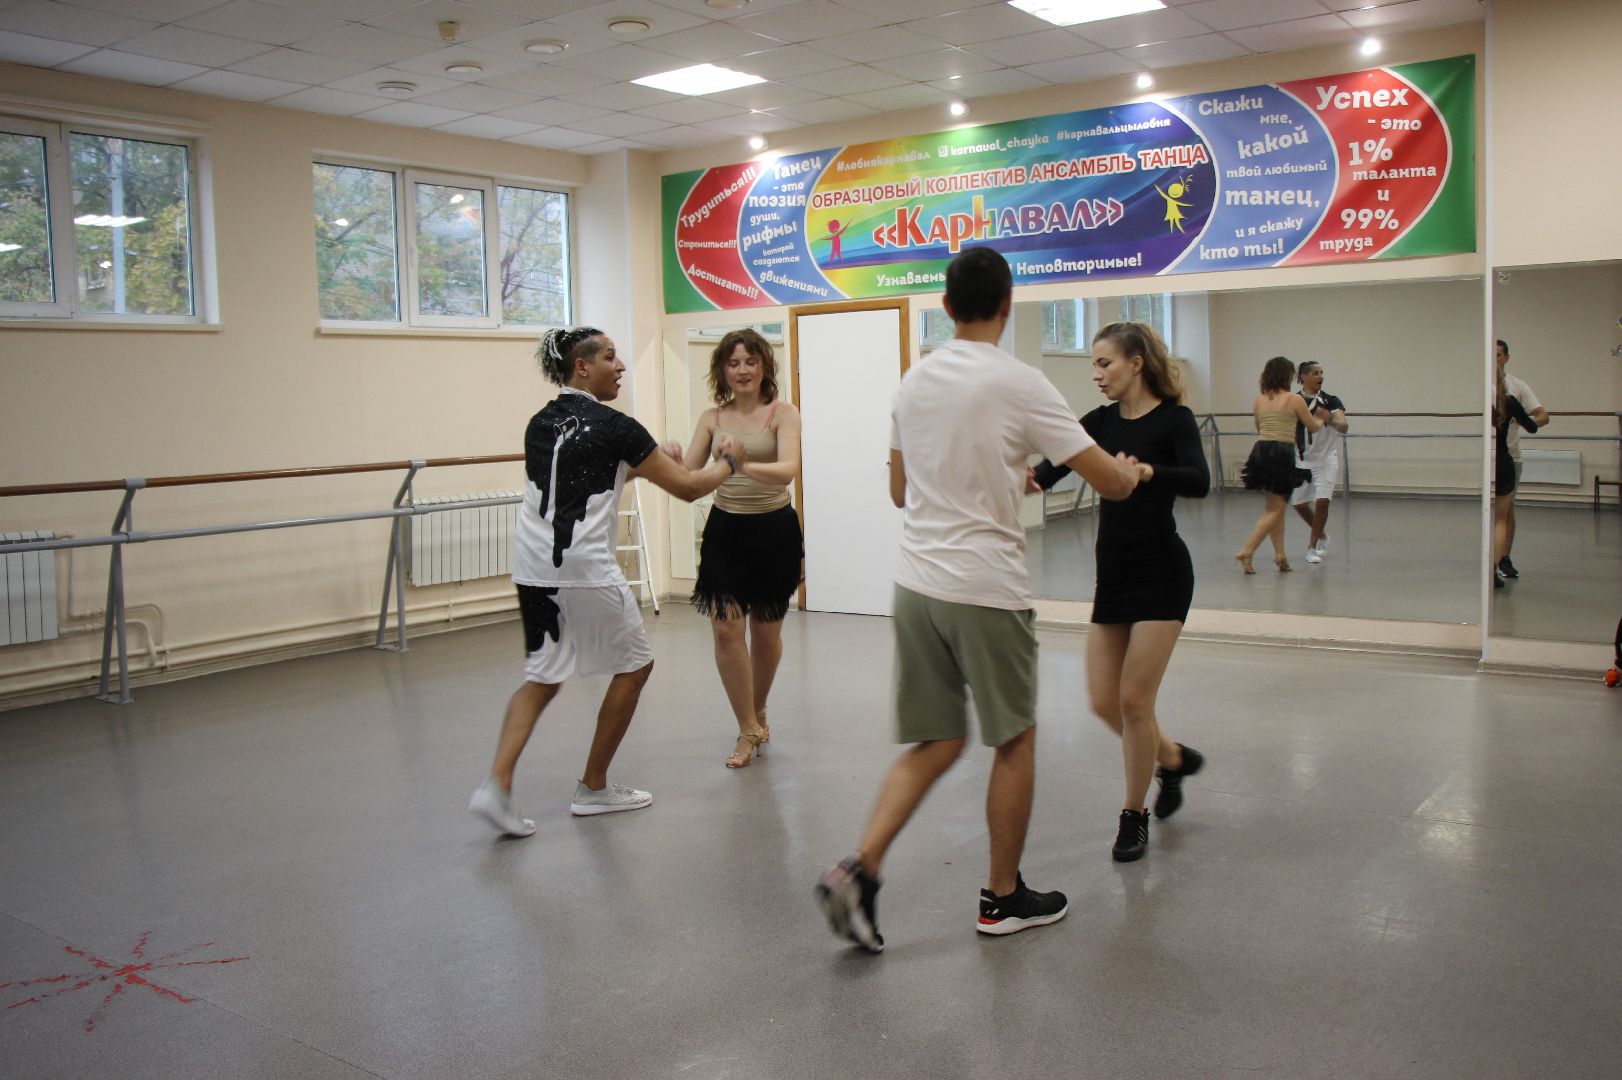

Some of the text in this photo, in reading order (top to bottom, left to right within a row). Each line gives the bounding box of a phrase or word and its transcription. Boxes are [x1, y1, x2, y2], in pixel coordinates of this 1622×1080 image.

[1198, 94, 1264, 116] Скажи
[1316, 85, 1409, 110] Успех
[1259, 114, 1293, 125] мне,
[1380, 118, 1422, 131] это
[1237, 125, 1309, 160] какой
[1348, 137, 1393, 166] 1%
[773, 157, 821, 180] Танец
[811, 144, 1209, 209] ОБРАЗЦОВЫЙ КОЛЛЕКТИВ АНСАМБЛЬ ТАНЦА
[1226, 160, 1328, 178] твой любимый
[1352, 166, 1437, 181] таланта
[680, 166, 756, 228] Трудиться!!!
[781, 182, 804, 192] это
[1377, 190, 1390, 202] и
[749, 195, 806, 207] поэзия
[1225, 190, 1320, 208] танец,
[1235, 217, 1304, 238] и я скажу
[1340, 208, 1400, 230] 99%
[743, 221, 797, 252] рифмы
[1319, 235, 1373, 251] труда
[1199, 238, 1284, 260] кто ты!
[752, 256, 800, 267] создаются
[1016, 252, 1142, 275] Неповторимые!
[687, 263, 758, 299] Достигать!!!
